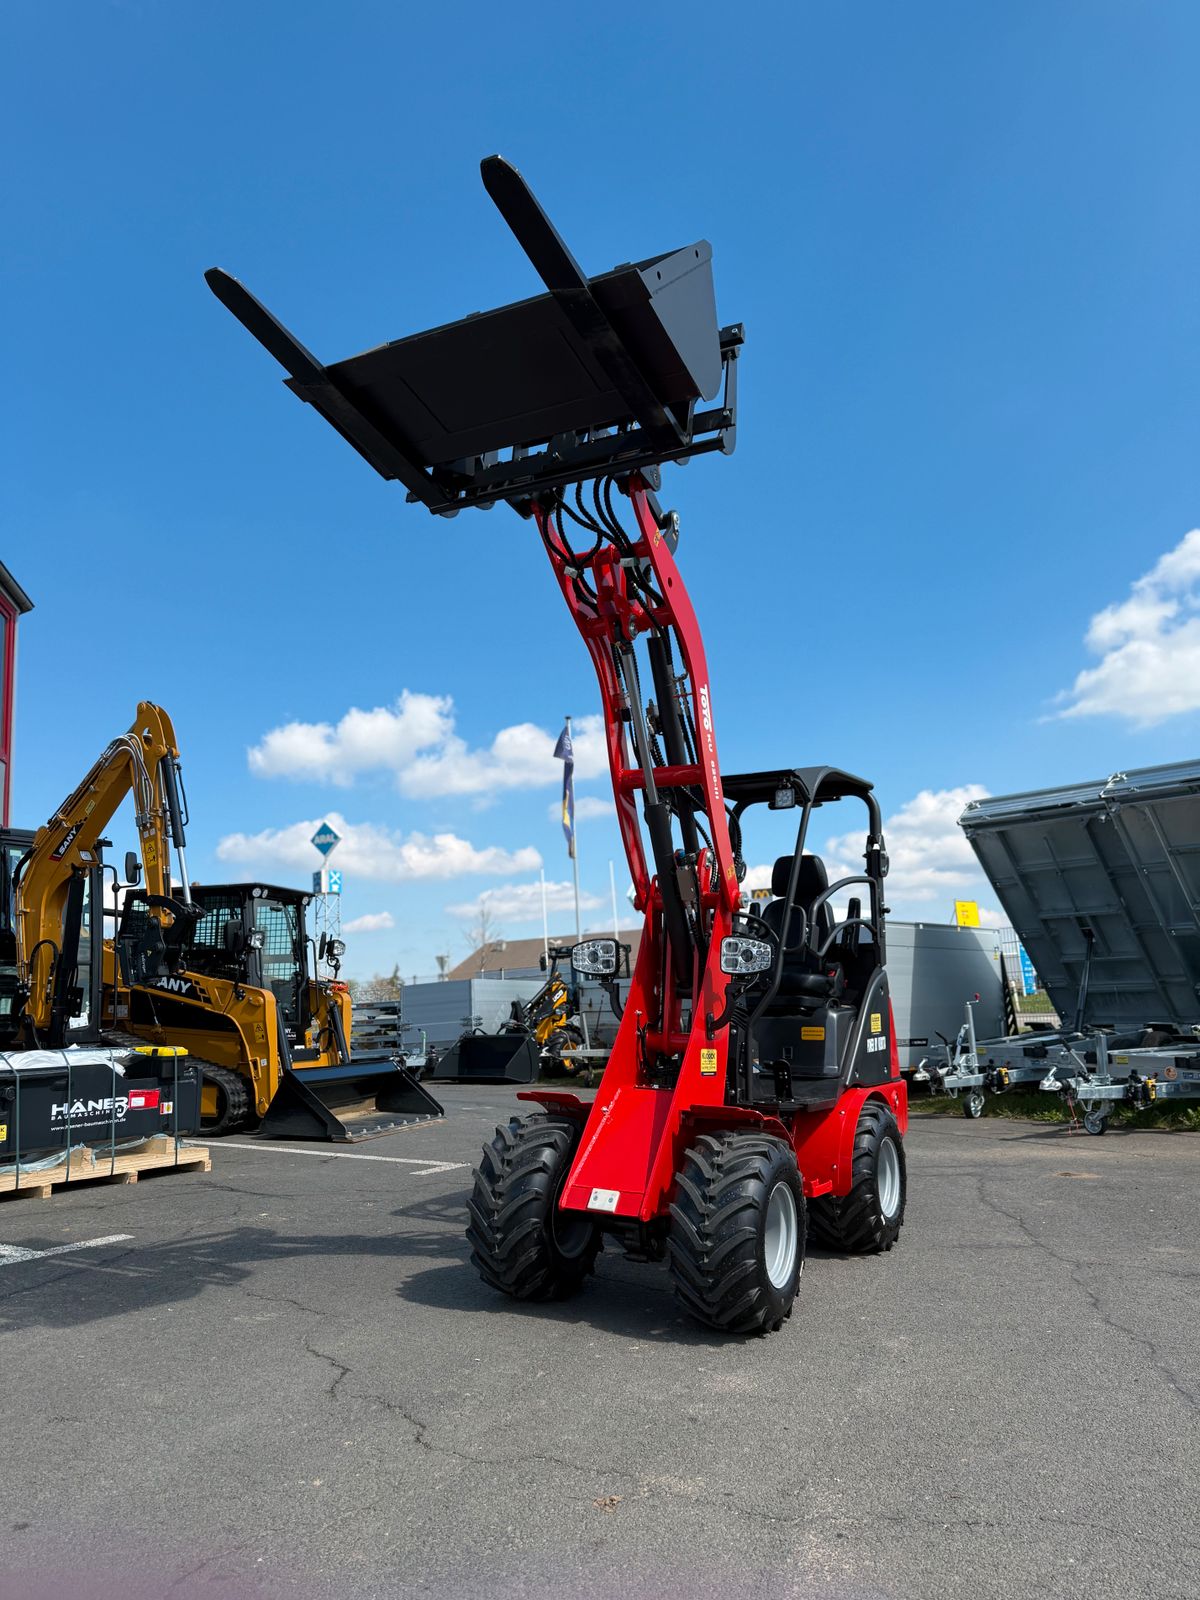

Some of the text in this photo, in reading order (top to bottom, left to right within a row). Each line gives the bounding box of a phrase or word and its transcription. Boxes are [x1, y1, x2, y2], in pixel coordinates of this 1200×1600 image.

[700, 684, 712, 732] TOYO
[59, 826, 77, 855] SANY
[156, 976, 191, 994] ANY
[51, 1097, 128, 1117] HÄNER
[51, 1108, 122, 1121] BAUMASCHINN
